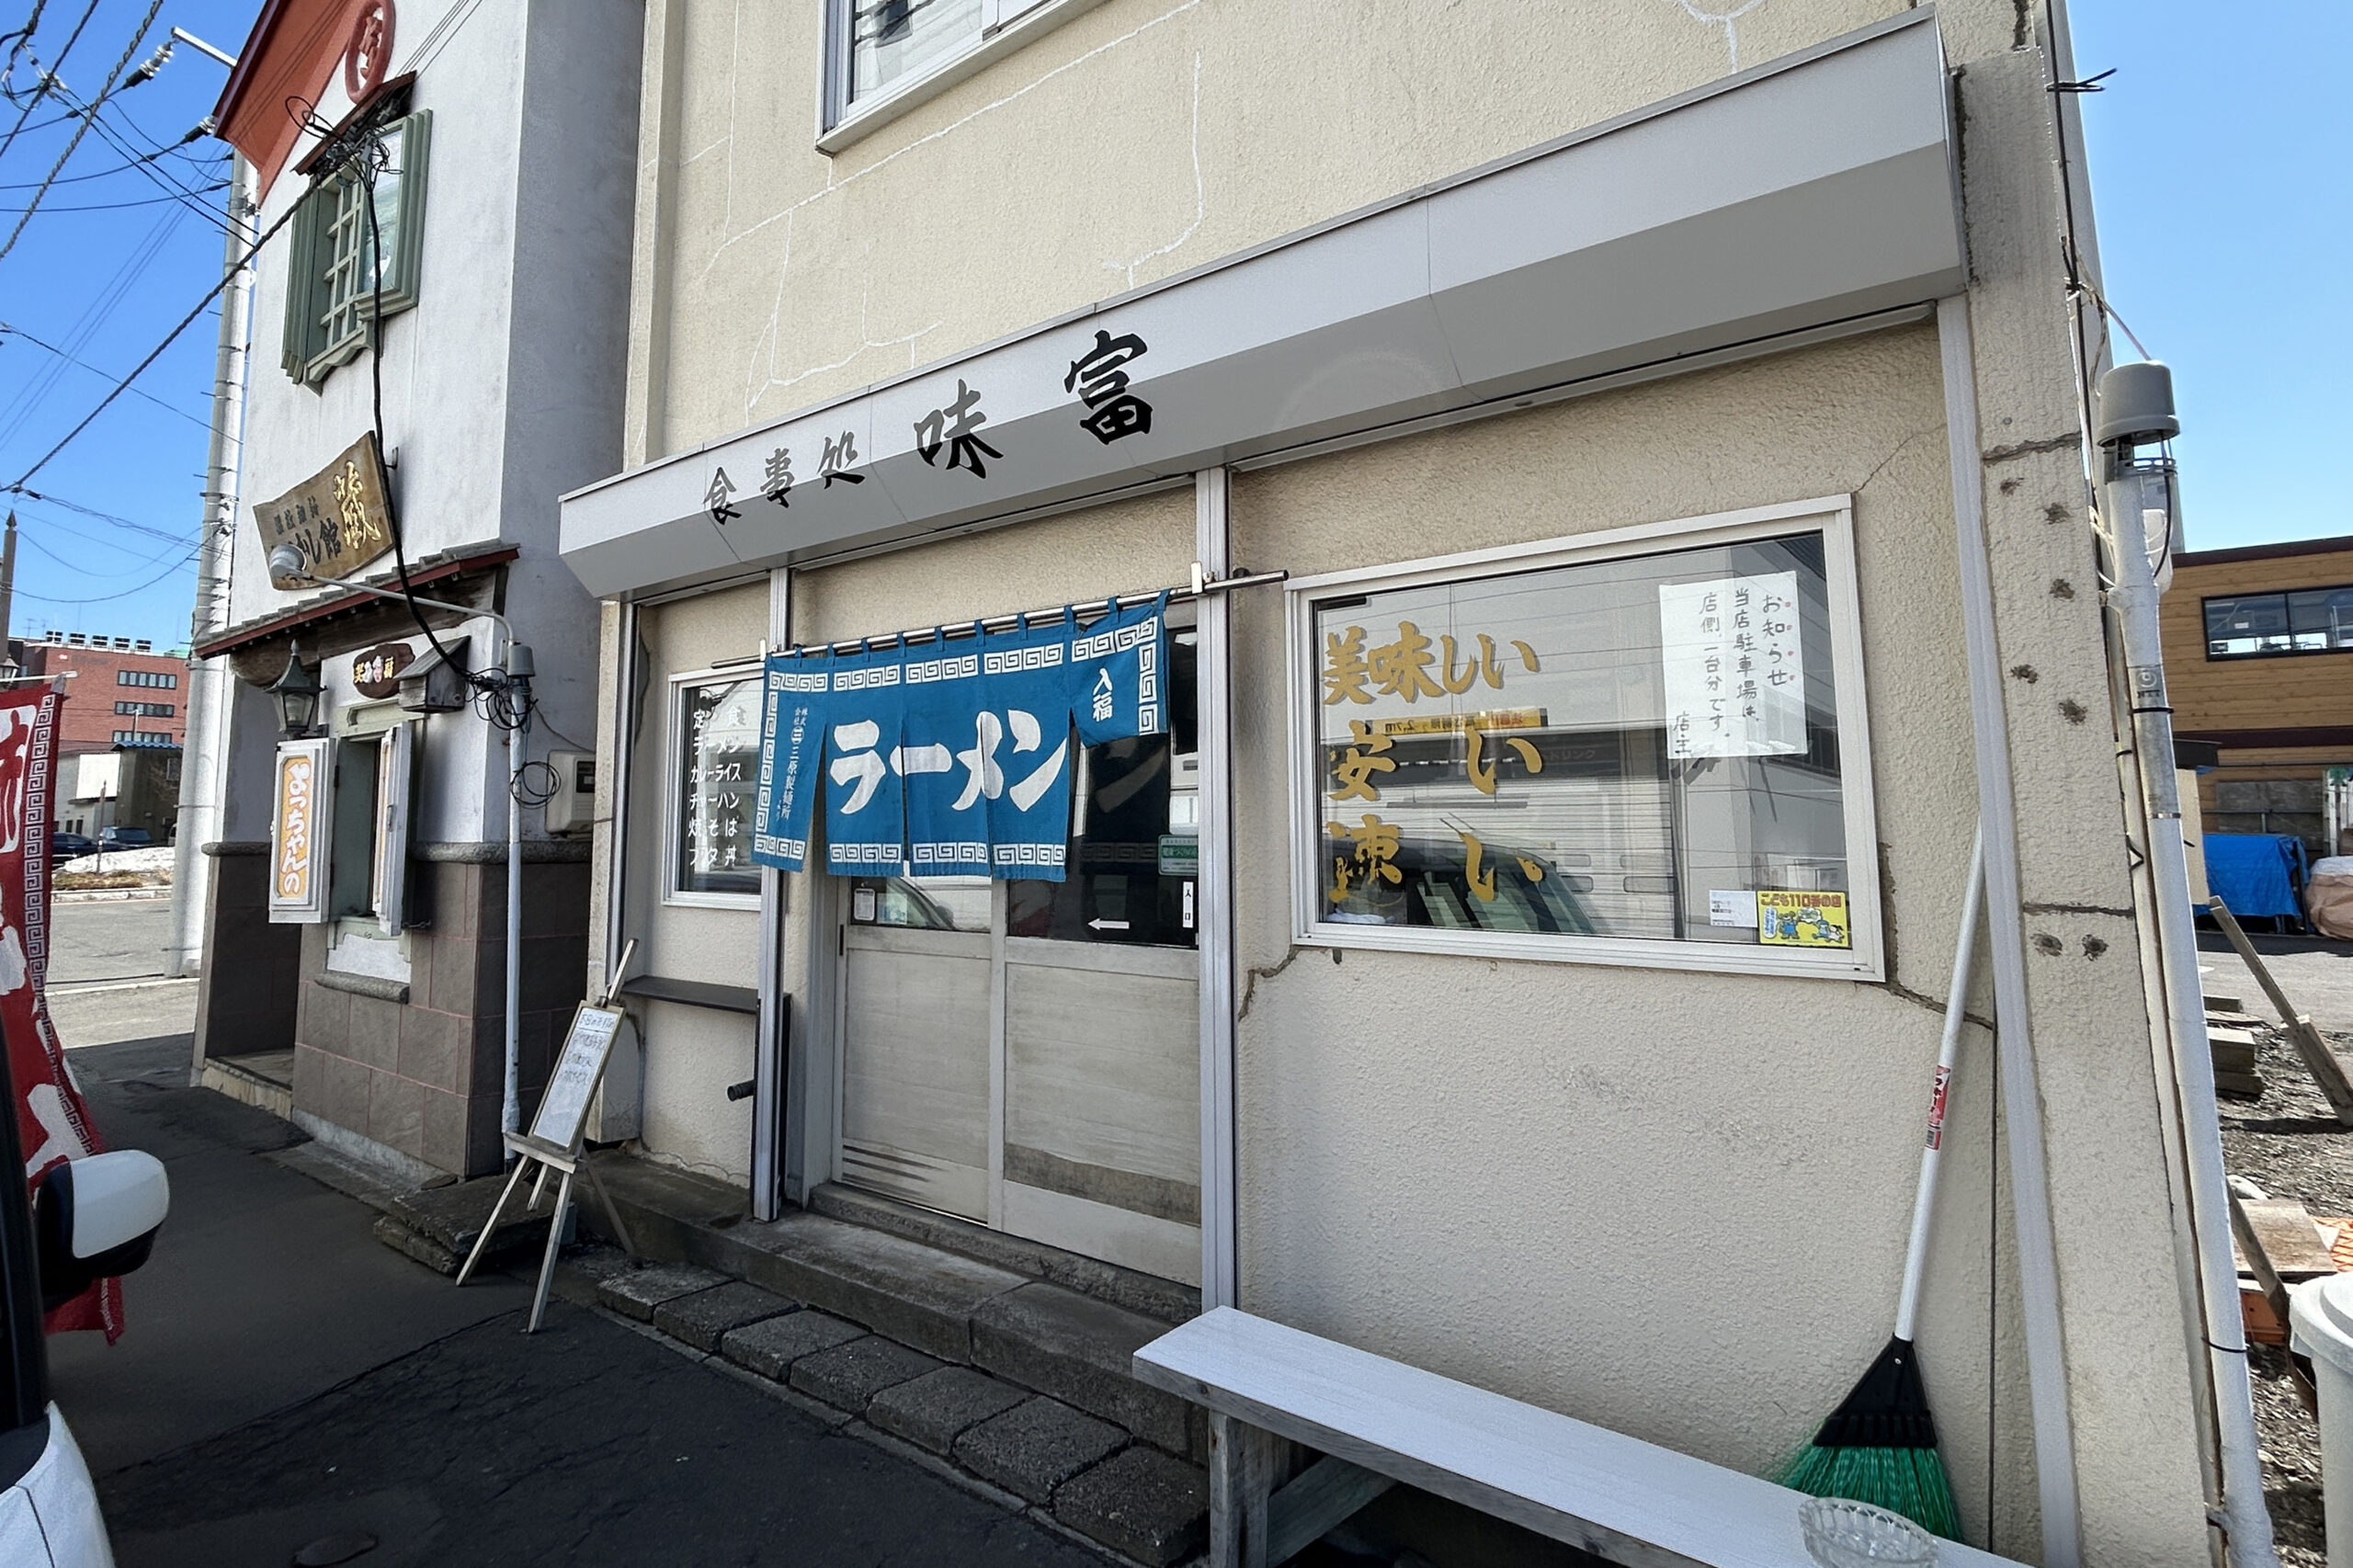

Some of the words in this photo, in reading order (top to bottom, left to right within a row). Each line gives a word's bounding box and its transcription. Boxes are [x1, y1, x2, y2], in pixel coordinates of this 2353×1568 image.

[702, 430, 865, 526] 食事処
[913, 329, 1154, 479] 味富
[1323, 620, 1540, 704] 美味しい
[1733, 587, 1760, 722] 当店駐車場は、
[1762, 595, 1788, 687] お知らせ
[1093, 667, 1113, 722] 入福
[2137, 689, 2161, 699] NTT
[693, 706, 741, 730] 定食
[1673, 710, 1691, 754] 店主
[693, 736, 742, 756] ラーメン
[830, 709, 1068, 814] ラーメン
[689, 762, 742, 784] カレーライス
[689, 791, 740, 811] チャーハン
[280, 762, 312, 894] よっちゃんの
[688, 816, 739, 838] 焼そば
[1184, 889, 1192, 920] 入口
